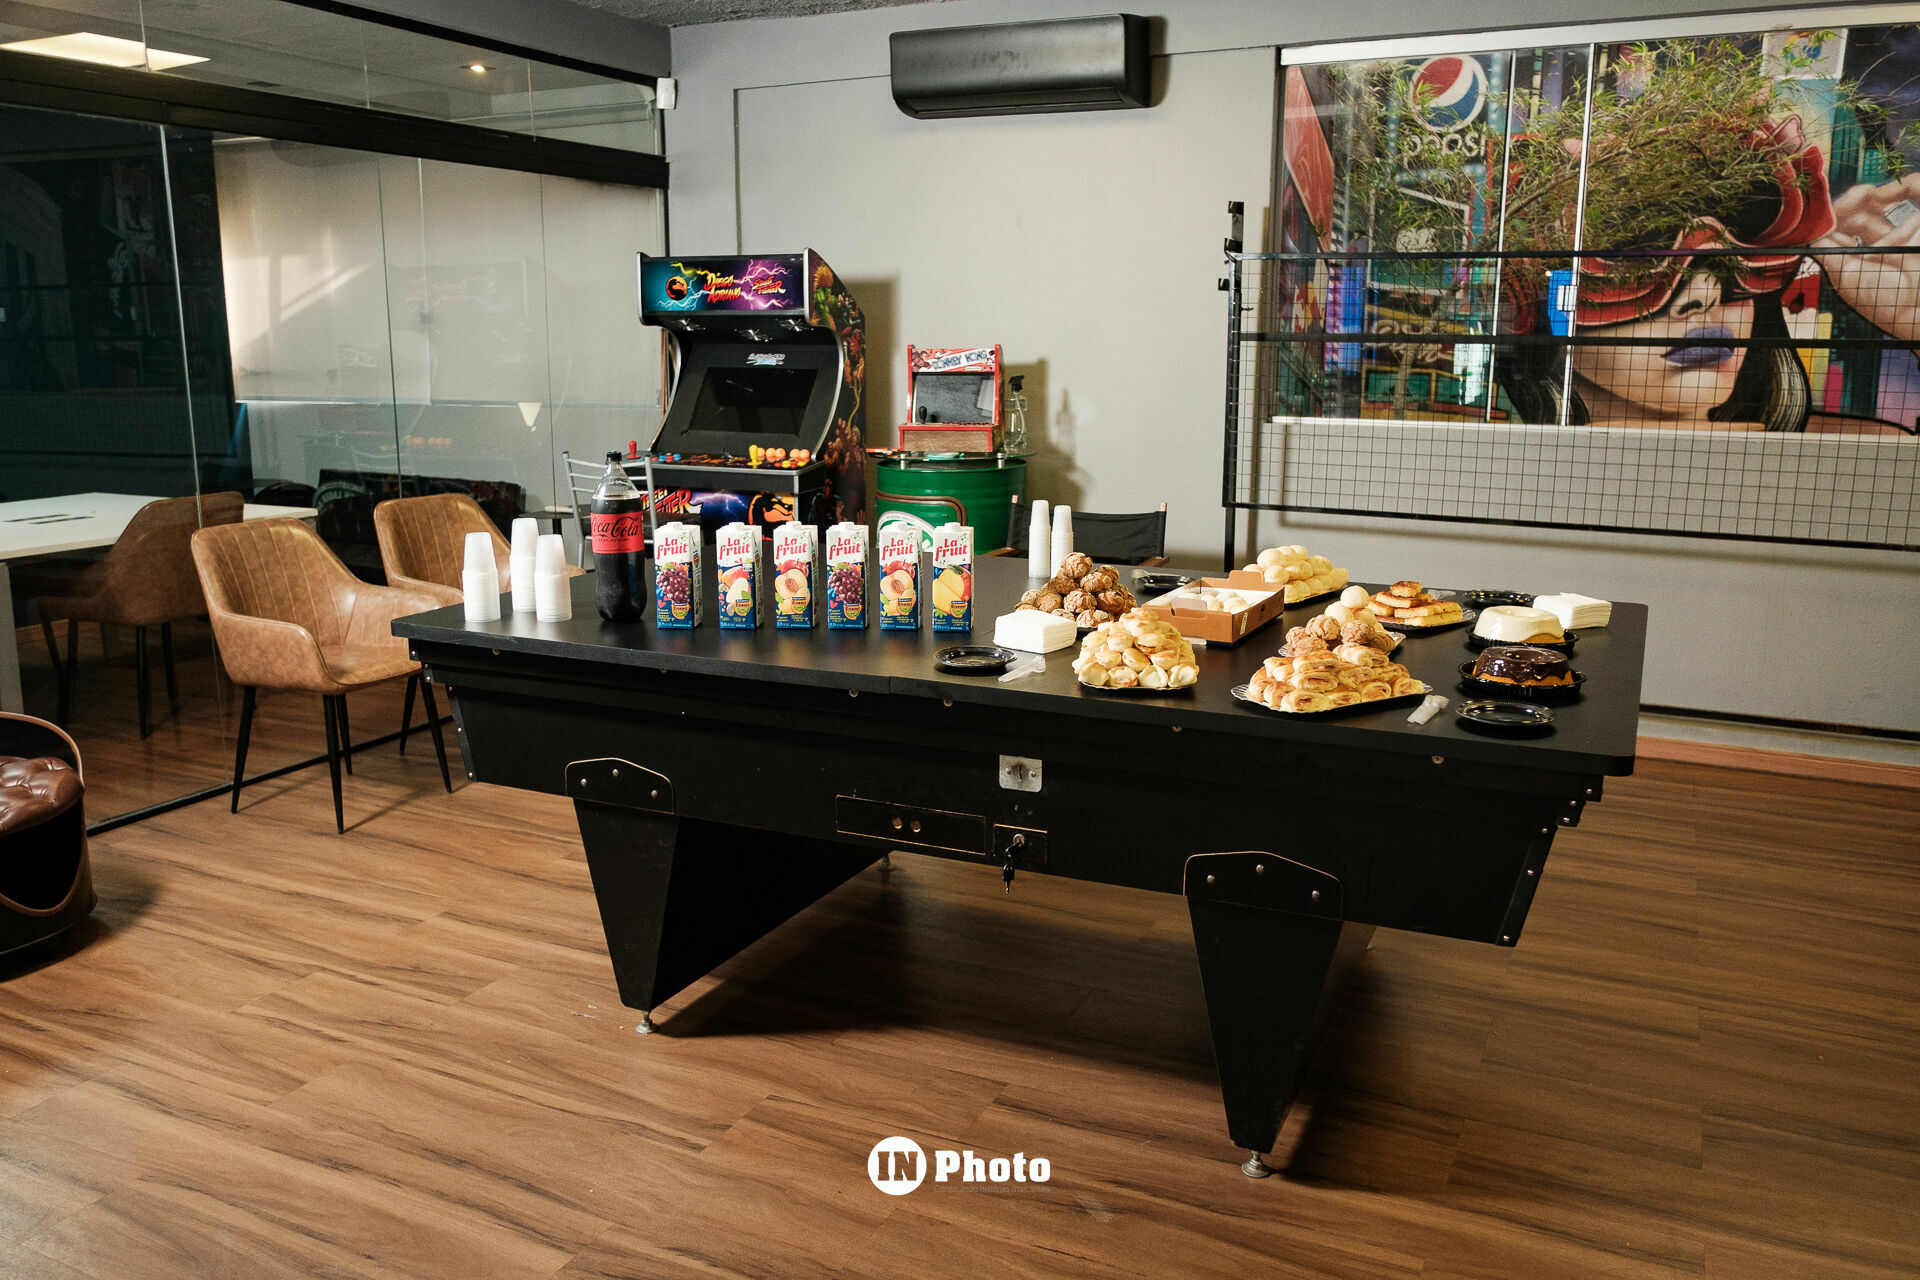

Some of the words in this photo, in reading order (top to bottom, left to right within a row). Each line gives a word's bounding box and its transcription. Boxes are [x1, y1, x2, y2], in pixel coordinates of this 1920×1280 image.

[665, 538, 678, 546] La
[728, 538, 740, 546] La
[784, 537, 798, 546] La
[838, 537, 850, 546] La
[891, 538, 904, 547] La
[944, 538, 958, 548] La
[656, 543, 688, 560] fruit
[720, 543, 750, 560] fruit
[776, 542, 807, 560] fruit
[829, 543, 860, 560] fruit
[882, 544, 914, 560] fruit
[935, 544, 968, 562] fruit
